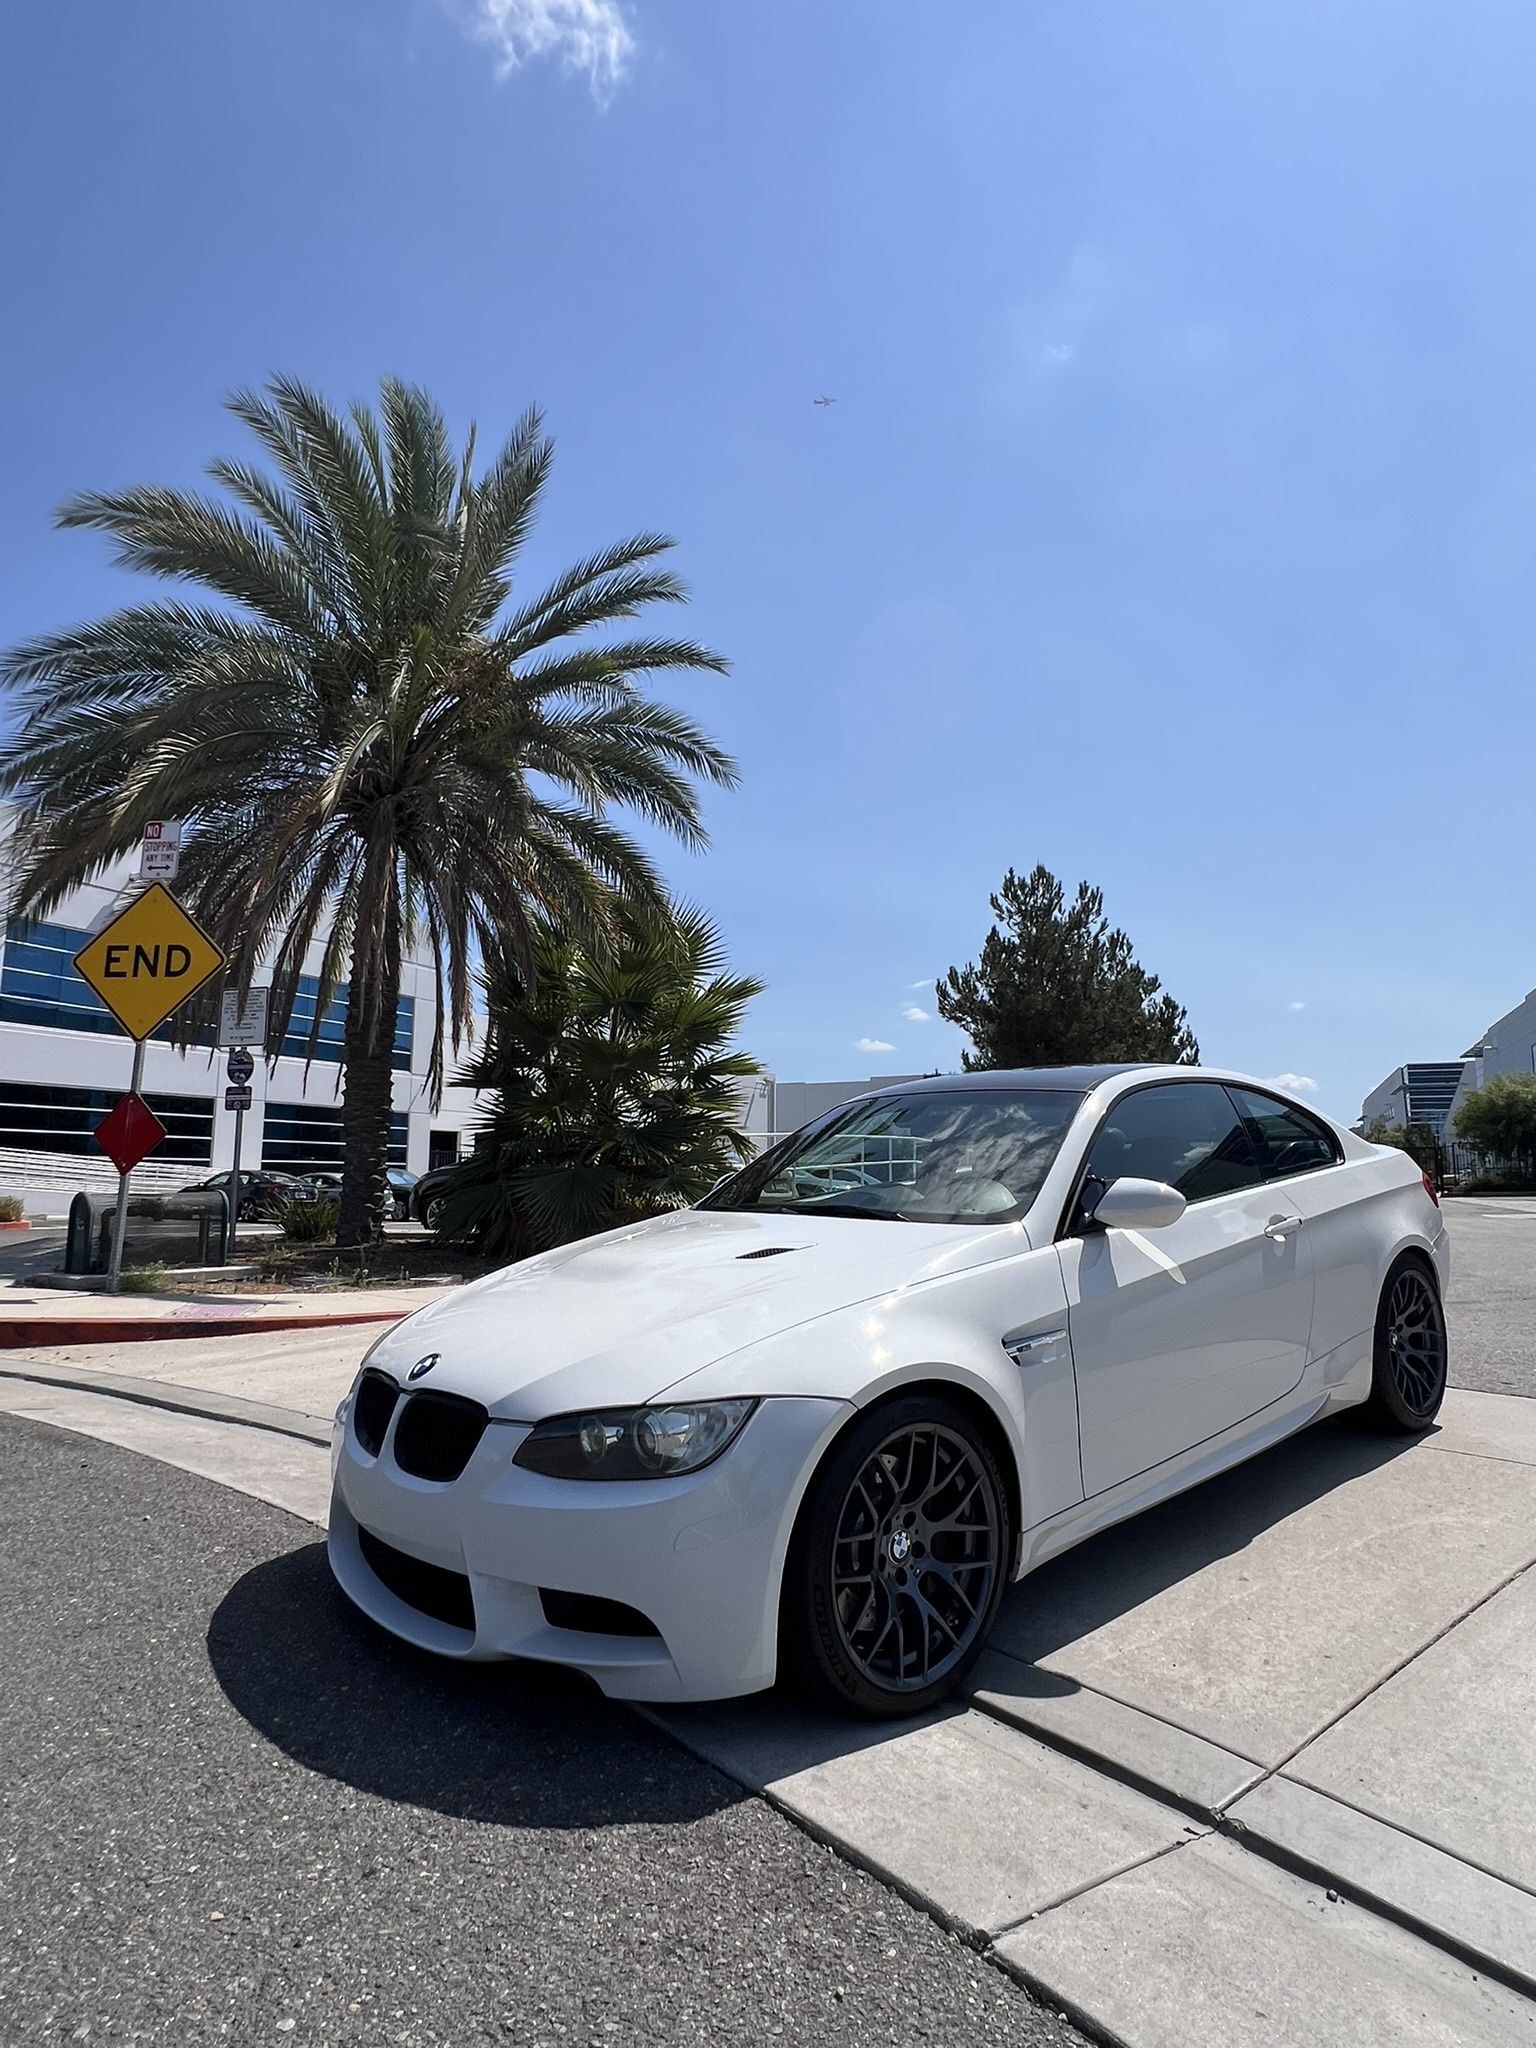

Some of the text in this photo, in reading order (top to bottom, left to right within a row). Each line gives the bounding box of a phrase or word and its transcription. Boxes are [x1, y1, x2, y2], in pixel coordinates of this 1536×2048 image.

[146, 824, 160, 838] NO
[144, 841, 177, 852] STOPPING
[145, 853, 174, 862] ANY TIME
[103, 944, 192, 978] END
